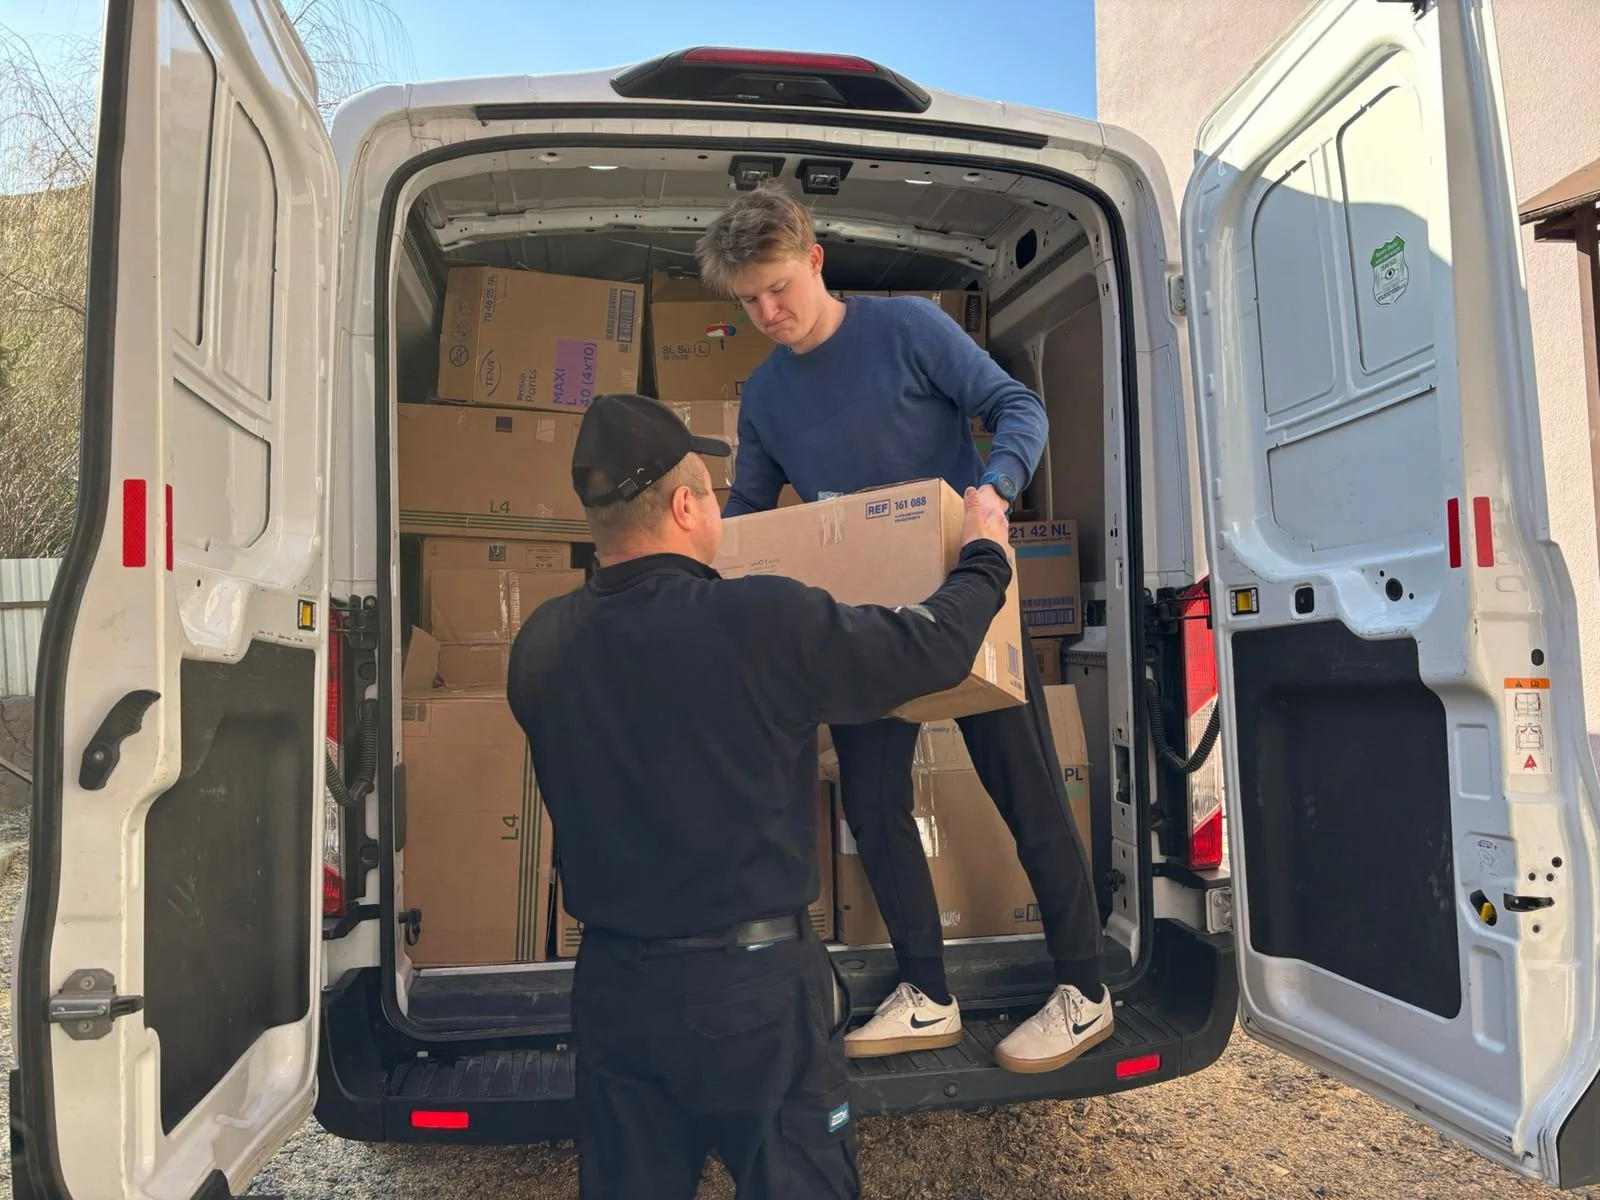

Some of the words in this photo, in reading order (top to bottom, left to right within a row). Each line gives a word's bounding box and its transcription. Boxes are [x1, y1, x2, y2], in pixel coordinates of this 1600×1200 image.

[485, 360, 495, 387] TENA
[525, 369, 538, 402] Pants
[553, 368, 566, 404] MAXI
[566, 398, 577, 406] L
[489, 500, 512, 514] L4
[868, 503, 889, 516] REF
[894, 499, 909, 511] 161
[910, 496, 927, 508] 088
[1009, 526, 1025, 539] 21
[1030, 525, 1047, 537] 42
[1051, 523, 1071, 537] NL
[1064, 767, 1084, 782] PL
[501, 813, 520, 840] L4
